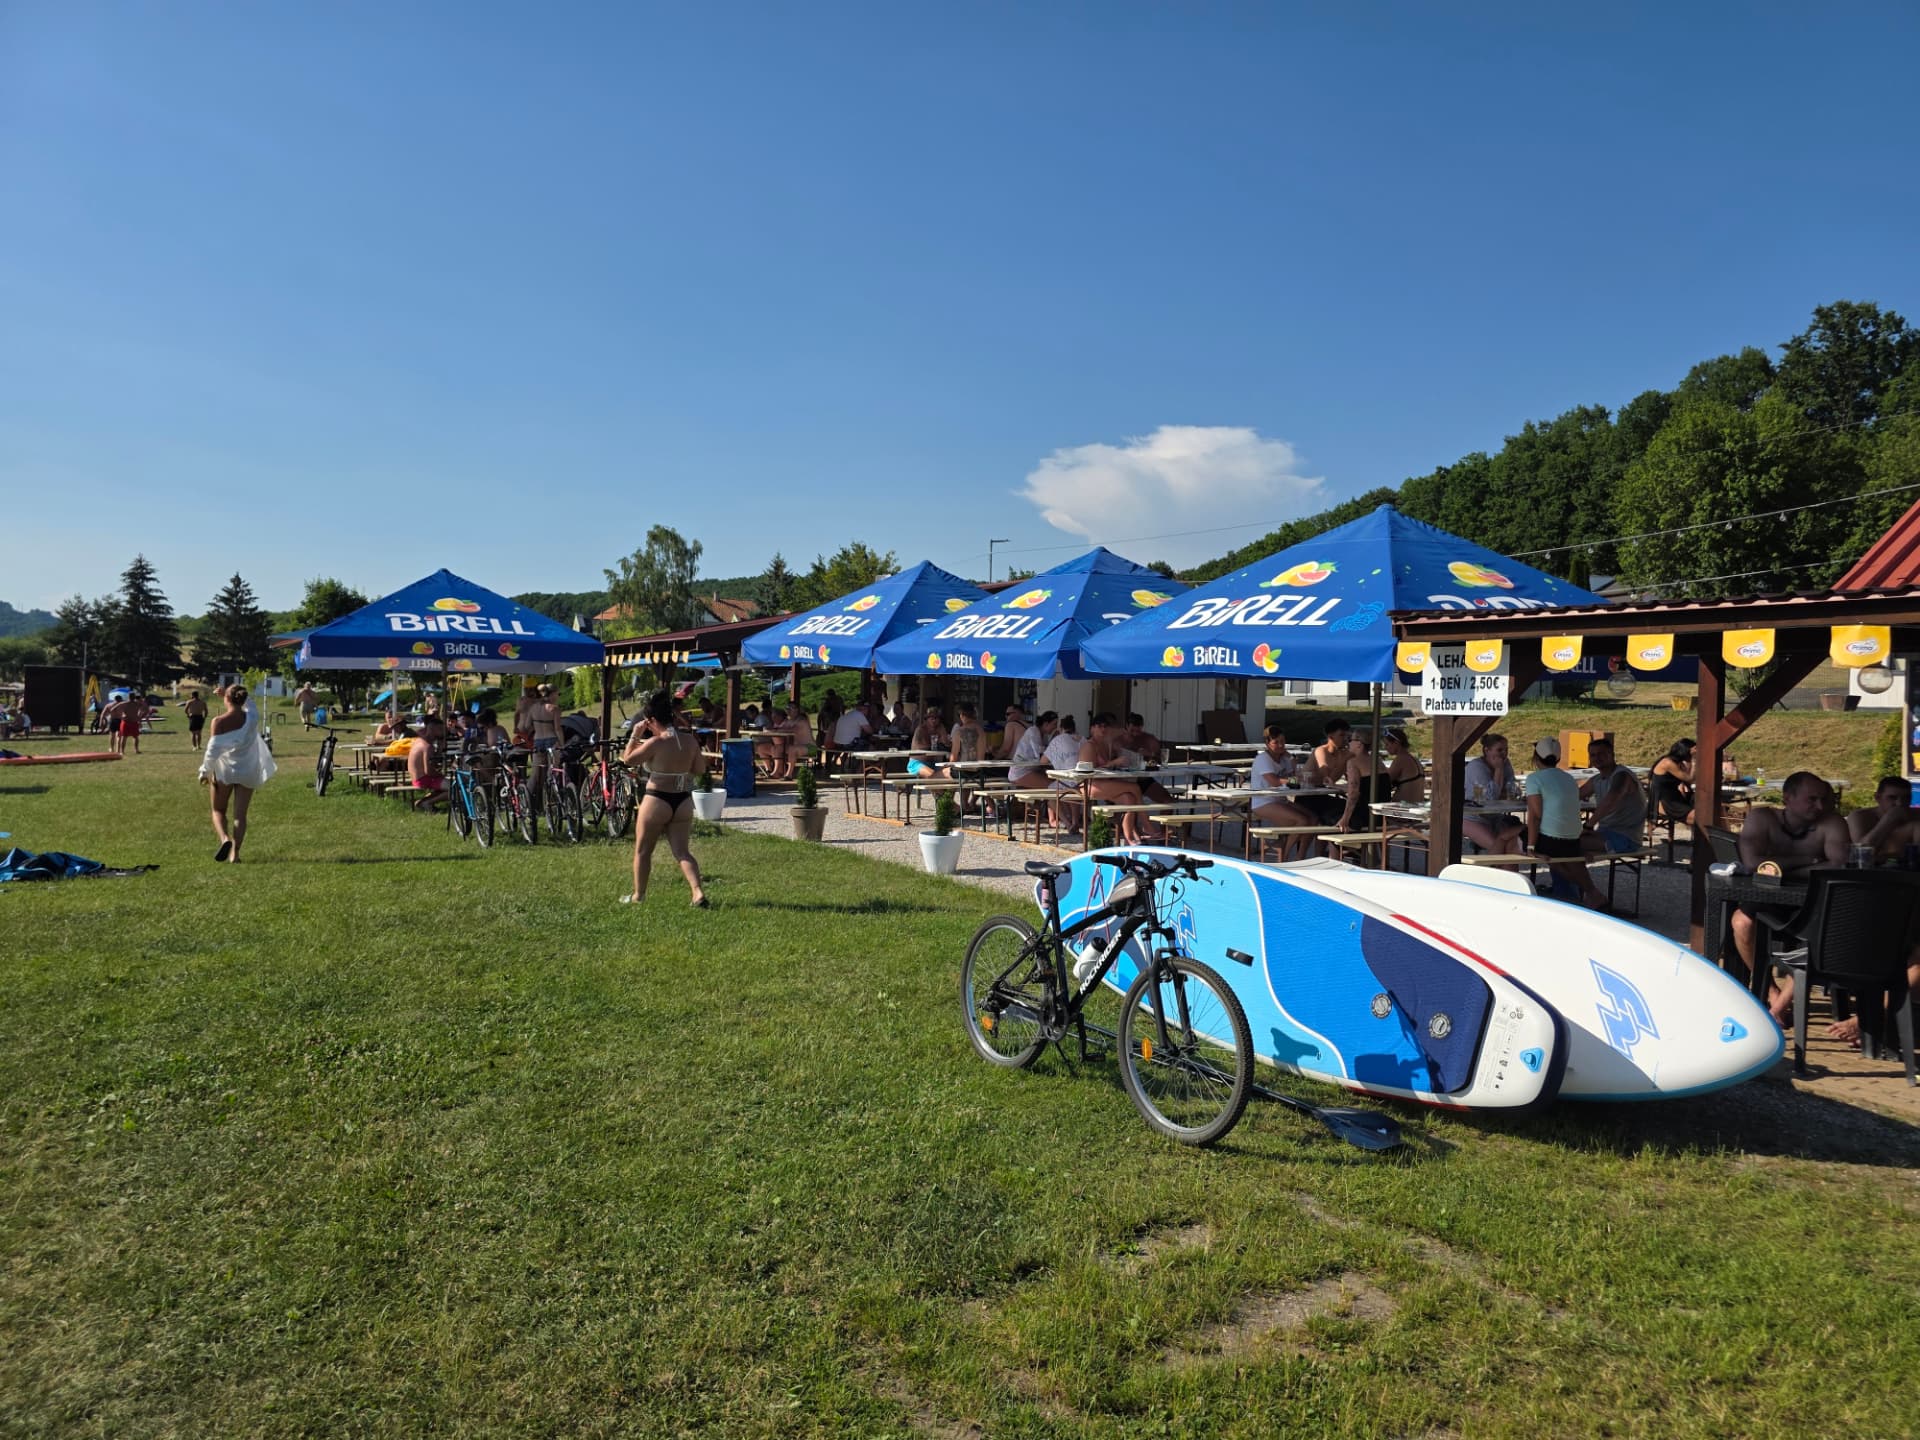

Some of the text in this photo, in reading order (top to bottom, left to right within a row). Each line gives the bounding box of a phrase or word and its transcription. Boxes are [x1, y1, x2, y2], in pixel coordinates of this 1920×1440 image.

[1437, 655, 1466, 668] LEHA
[1431, 676, 1436, 690] 1
[1470, 676, 1500, 692] 2,50€
[1425, 698, 1503, 711] Platba v bufete
[1079, 928, 1122, 995] ROCKRIDER
